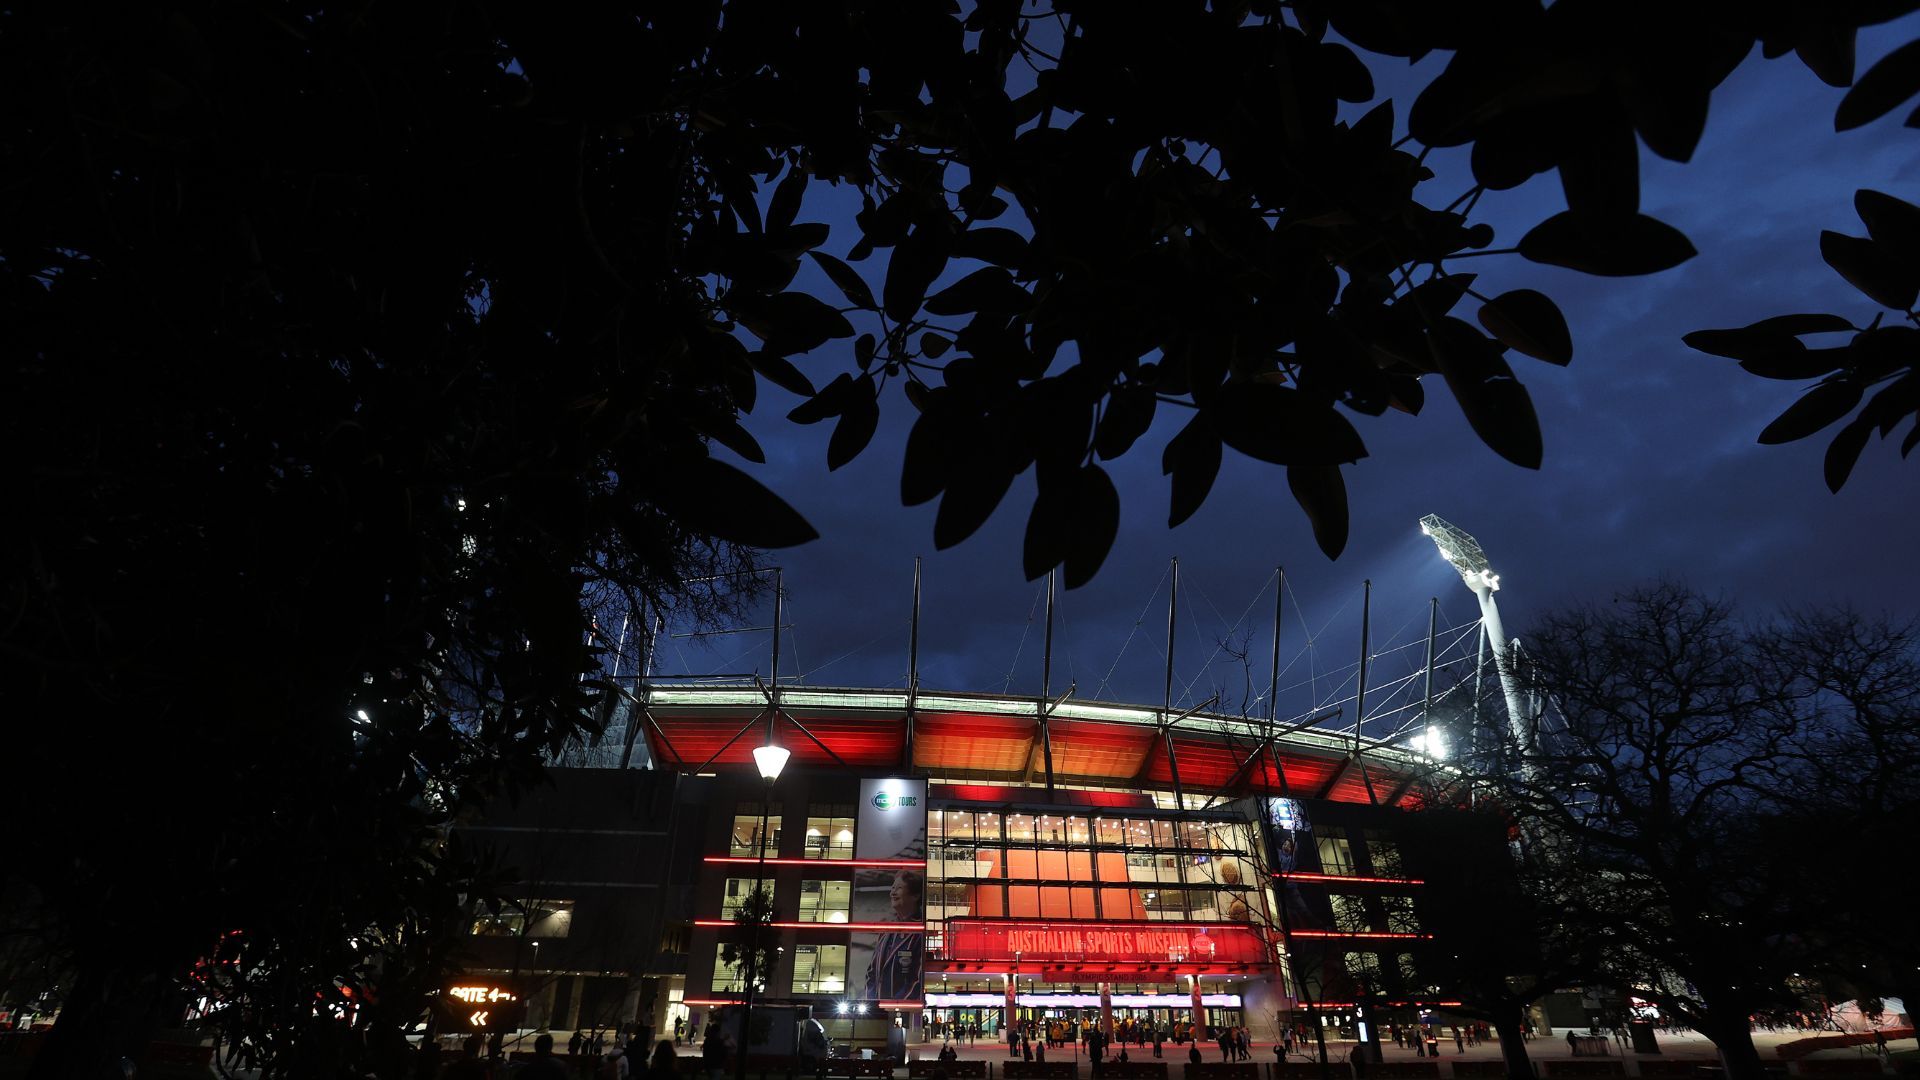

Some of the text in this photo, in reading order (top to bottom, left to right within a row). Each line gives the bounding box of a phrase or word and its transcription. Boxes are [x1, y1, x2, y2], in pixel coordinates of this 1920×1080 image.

[898, 797, 917, 806] TOURS
[1008, 930, 1190, 954] AUSTRALIAN SPORTS MUSEUM
[1072, 973, 1105, 981] OLYMPIC
[1105, 973, 1129, 981] STAND
